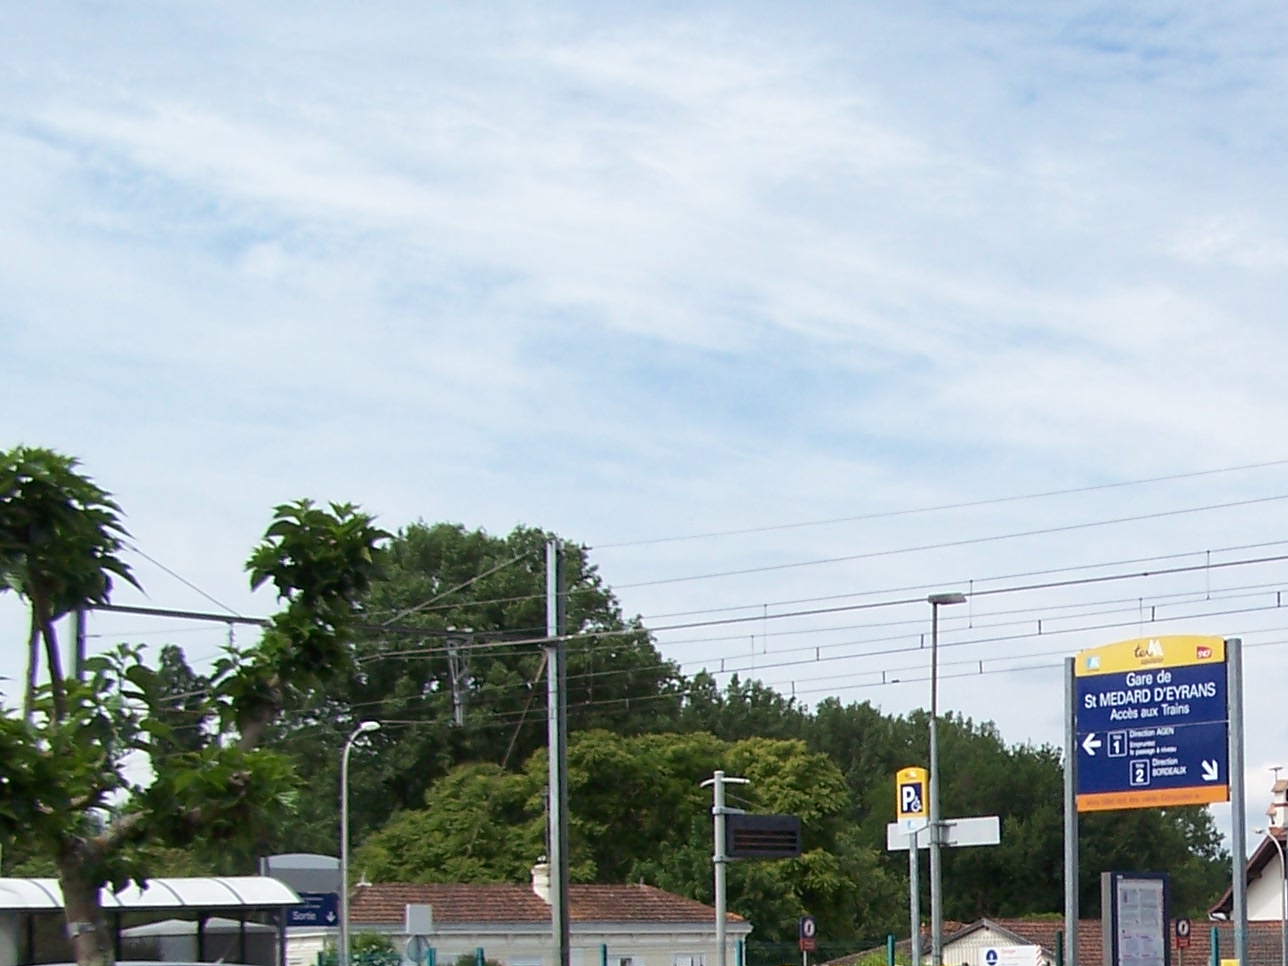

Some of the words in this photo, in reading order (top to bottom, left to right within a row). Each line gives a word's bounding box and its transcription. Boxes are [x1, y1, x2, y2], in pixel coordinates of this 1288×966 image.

[1126, 671, 1153, 687] Gare
[1156, 670, 1172, 684] de
[1084, 694, 1097, 709] St
[1100, 688, 1151, 707] MEDARD
[1154, 682, 1216, 702] D'EYRANS
[1110, 707, 1138, 720] Accès
[1141, 708, 1159, 719] aux
[1161, 702, 1190, 716] Trains
[1129, 729, 1156, 739] Direction
[1113, 740, 1120, 754] 1
[1135, 769, 1144, 783] 2
[1152, 766, 1187, 777] BORDEAUX
[902, 786, 916, 812] P
